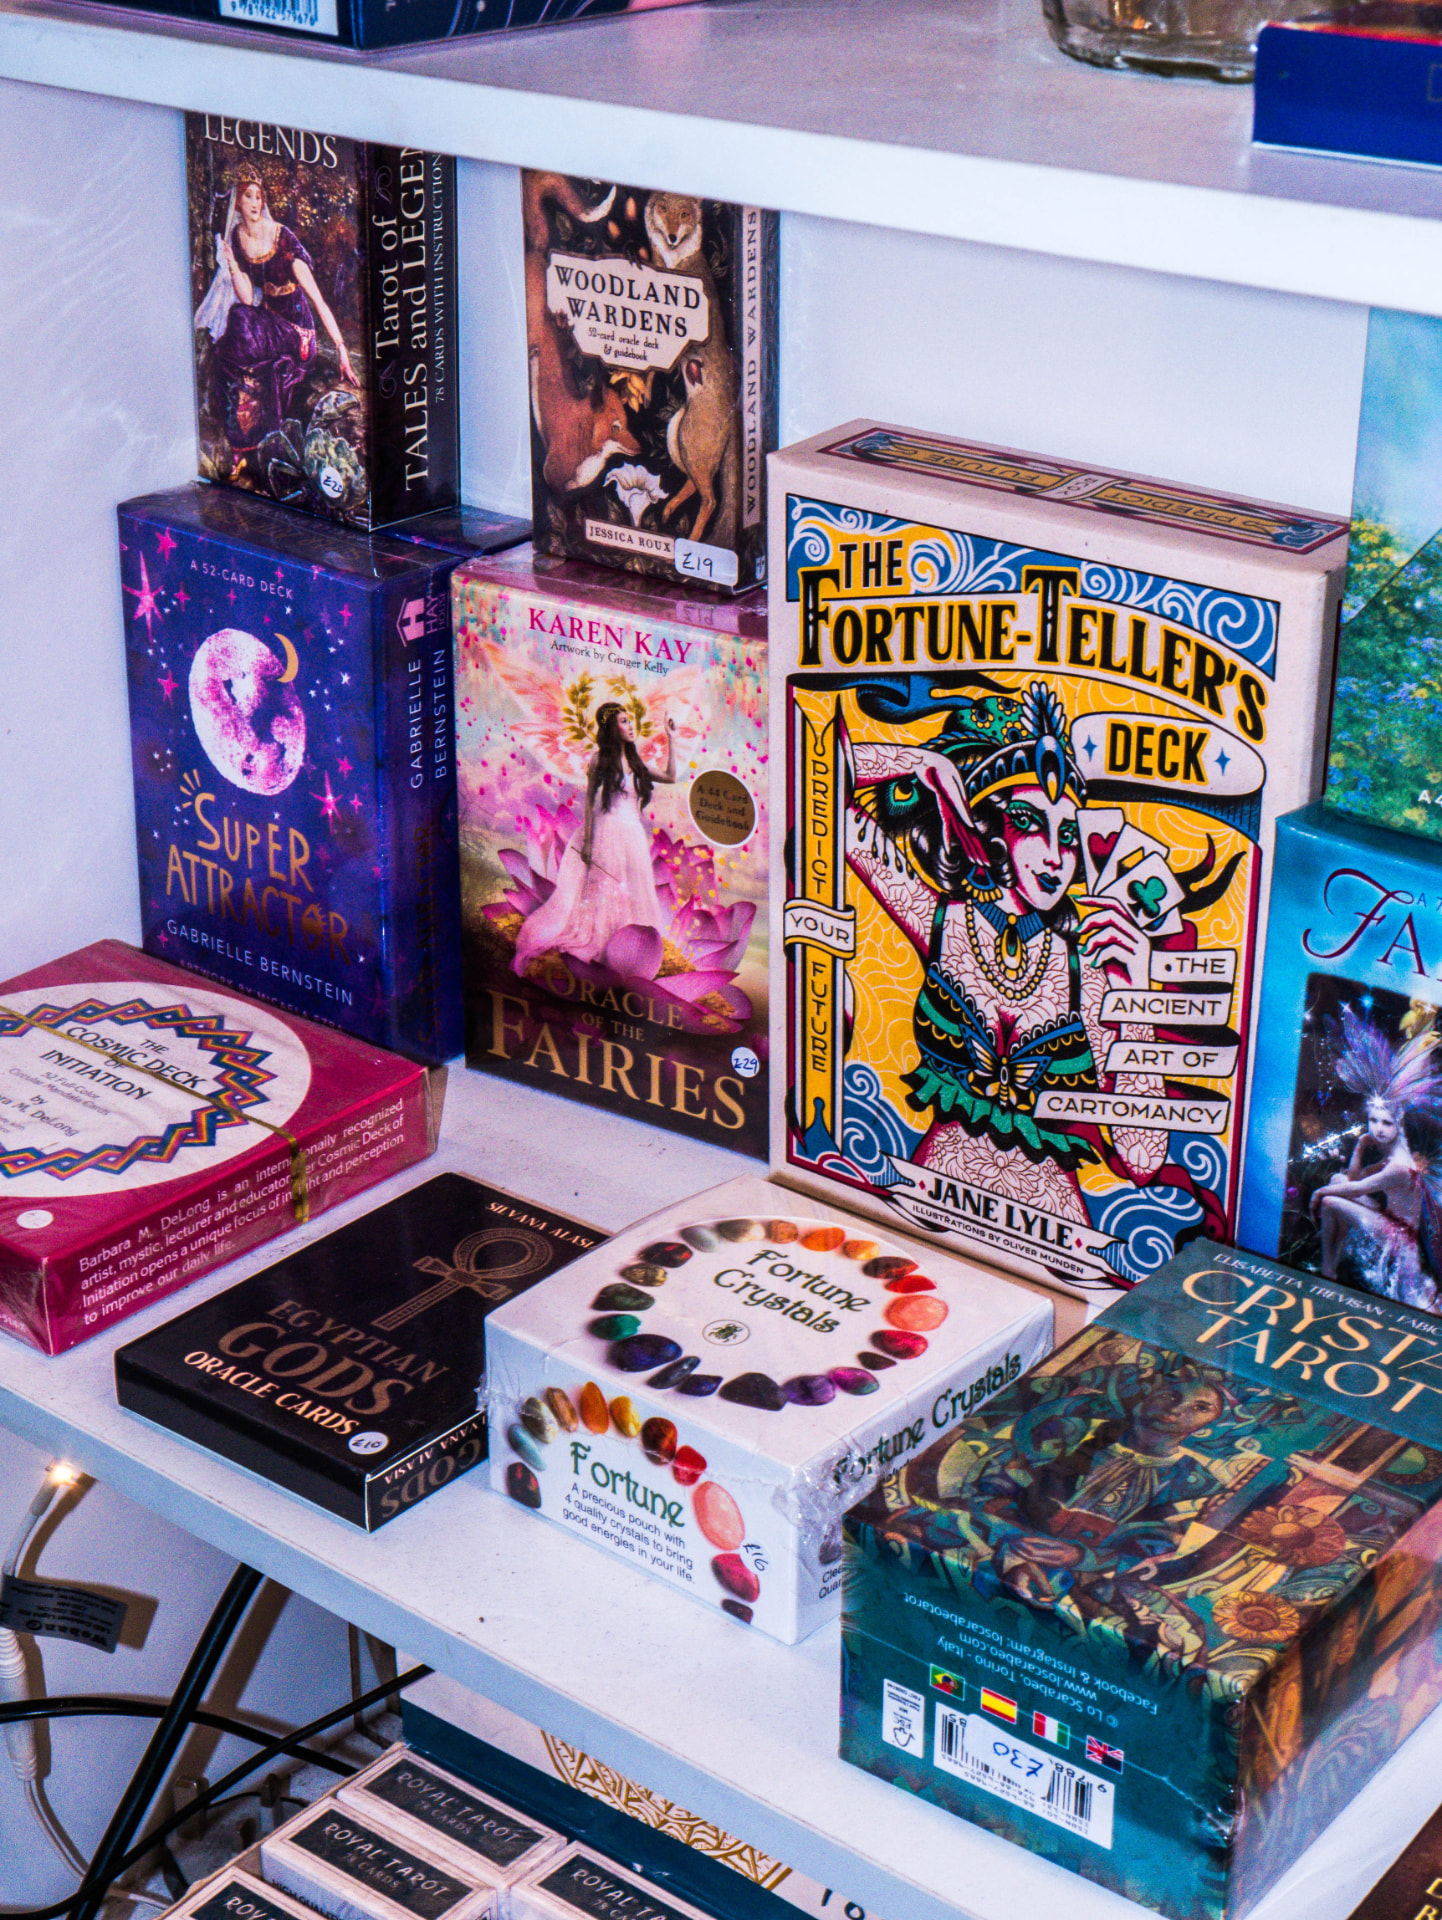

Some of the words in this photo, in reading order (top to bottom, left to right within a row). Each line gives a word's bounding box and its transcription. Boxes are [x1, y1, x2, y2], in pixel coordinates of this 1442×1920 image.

[203, 114, 338, 169] LEGENDS
[373, 214, 398, 250] of
[433, 281, 445, 323] WITH
[555, 265, 700, 309] WOODLAND
[747, 210, 757, 347] WARDENS
[375, 259, 399, 360] Tarot
[402, 283, 427, 349] and
[566, 296, 688, 337] WARDENS
[588, 327, 615, 342] 52-card
[618, 333, 640, 346] oracle
[643, 337, 659, 349] deck
[434, 327, 446, 384] CARDS
[613, 345, 648, 361] guidebook
[435, 388, 446, 403] 78
[404, 362, 429, 491] TALES
[747, 359, 757, 514] WOODLAND
[589, 526, 634, 544] JESSICA
[639, 537, 672, 553] ROUX
[682, 552, 713, 577] £19
[839, 540, 903, 589] THE
[190, 561, 198, 572] A
[202, 564, 255, 588] 52-CARD
[260, 580, 294, 600] DECK
[425, 596, 439, 635] HAY
[528, 608, 624, 649] KAREN
[634, 630, 692, 664] KAY
[550, 639, 591, 659] Artwork
[593, 649, 605, 663] by
[608, 653, 641, 670] Ginger
[644, 658, 669, 677] Kelly
[409, 658, 423, 789] GABRIELLE
[433, 648, 447, 780] BERNSTEIN
[1108, 722, 1208, 783] DECK
[194, 792, 314, 893] SUPER
[811, 759, 830, 894] PREDICT
[166, 844, 350, 965] ATTRACTOR
[790, 912, 850, 944] YOUR
[166, 919, 253, 967] GABRIELLE
[260, 956, 353, 1007] BERNSTEIN
[1176, 957, 1226, 975] THE
[546, 962, 683, 1030] ORACLE
[811, 962, 829, 1074] FUTURE
[1111, 997, 1222, 1016] ANCIENT
[140, 1039, 169, 1055] THE
[581, 1012, 603, 1027] OF
[611, 1020, 645, 1042] THE
[40, 1049, 153, 1100] INITIATION
[66, 1026, 148, 1066] COSMIC
[143, 1059, 208, 1089] DECK
[486, 988, 745, 1130] FAIRIES
[1123, 1049, 1174, 1067] ART
[1182, 1051, 1219, 1067] OF
[29, 1110, 80, 1137] DeLong
[30, 1094, 48, 1105] by
[1047, 1097, 1222, 1125] CARTOMANCY
[79, 1238, 131, 1272] Barbara
[138, 1226, 154, 1244] M.
[161, 1198, 211, 1232] DeLong
[217, 1189, 228, 1203] is
[234, 1178, 249, 1194] an
[343, 1098, 404, 1138] recognized
[80, 1267, 117, 1290] artist,
[119, 1241, 164, 1273] mystic,
[165, 1218, 213, 1248] lecturer
[213, 1201, 238, 1224] and
[317, 1139, 361, 1167] Cosmic
[361, 1122, 392, 1149] Deck
[391, 1114, 405, 1131] of
[82, 1273, 139, 1308] Initiation
[140, 1252, 179, 1282] opens
[180, 1244, 188, 1256] a
[189, 1221, 233, 1253] unique
[233, 1204, 266, 1230] focus
[267, 1193, 281, 1212] of
[321, 1160, 344, 1185] and
[344, 1134, 405, 1177] perception
[486, 1202, 548, 1230] SILVANA
[549, 1228, 595, 1249] ALASI
[912, 1204, 986, 1238] ILLUSTRATIONS
[988, 1233, 1002, 1244] BY
[1003, 1238, 1038, 1258] OLIVER
[1040, 1253, 1084, 1274] MUNDEN
[927, 1177, 999, 1223] JANE
[1004, 1203, 1073, 1251] LYLE
[83, 1311, 98, 1327] to
[101, 1281, 154, 1317] improve
[157, 1268, 178, 1287] our
[181, 1252, 210, 1276] daily
[213, 1239, 236, 1259] life.
[713, 1268, 841, 1333] Crystals
[746, 1249, 871, 1312] Fortune
[1213, 1253, 1302, 1289] ELISABETTA
[1309, 1286, 1386, 1317] TREVISAN
[217, 1321, 415, 1415] GODS
[266, 1299, 451, 1385] EGYPTIAN
[1196, 1310, 1442, 1413] TAROT
[183, 1350, 279, 1400] ORACLE
[275, 1391, 359, 1436] CARDS
[832, 1417, 925, 1485] Fortune
[932, 1352, 1021, 1428] Crystals
[380, 1438, 481, 1519] GODS
[383, 1447, 434, 1484] ALASIA
[570, 1441, 685, 1528] Fortune
[565, 1494, 572, 1504] 4
[575, 1500, 607, 1525] quality
[610, 1518, 650, 1546] crystals
[653, 1540, 663, 1552] to
[666, 1545, 693, 1570] bring
[571, 1483, 579, 1494] A
[582, 1489, 626, 1519] precious
[629, 1514, 660, 1537] pouch
[664, 1531, 686, 1549] with
[562, 1508, 588, 1527] good
[591, 1522, 635, 1552] energies
[638, 1546, 648, 1558] in
[650, 1554, 674, 1572] your
[676, 1566, 695, 1584] life.
[904, 1591, 1004, 1645] loscarabeotarot
[937, 1636, 963, 1659] Italy
[959, 1631, 1097, 1700] www.loscarabeo.com
[975, 1654, 1016, 1683] Torino
[1006, 1637, 1076, 1679] Instagram:
[1019, 1676, 1083, 1713] Scarabeo,
[1080, 1672, 1091, 1685] &
[1092, 1676, 1157, 1715] Facebook
[1087, 1707, 1103, 1723] Lo
[992, 1741, 1044, 1777] £30
[396, 1772, 458, 1808] ROYAL
[455, 1806, 521, 1843] TAROT
[322, 1823, 387, 1860] ROYAL
[383, 1857, 450, 1896] TAROT
[357, 1857, 400, 1889] CARDS
[570, 1869, 637, 1907] ROYAL
